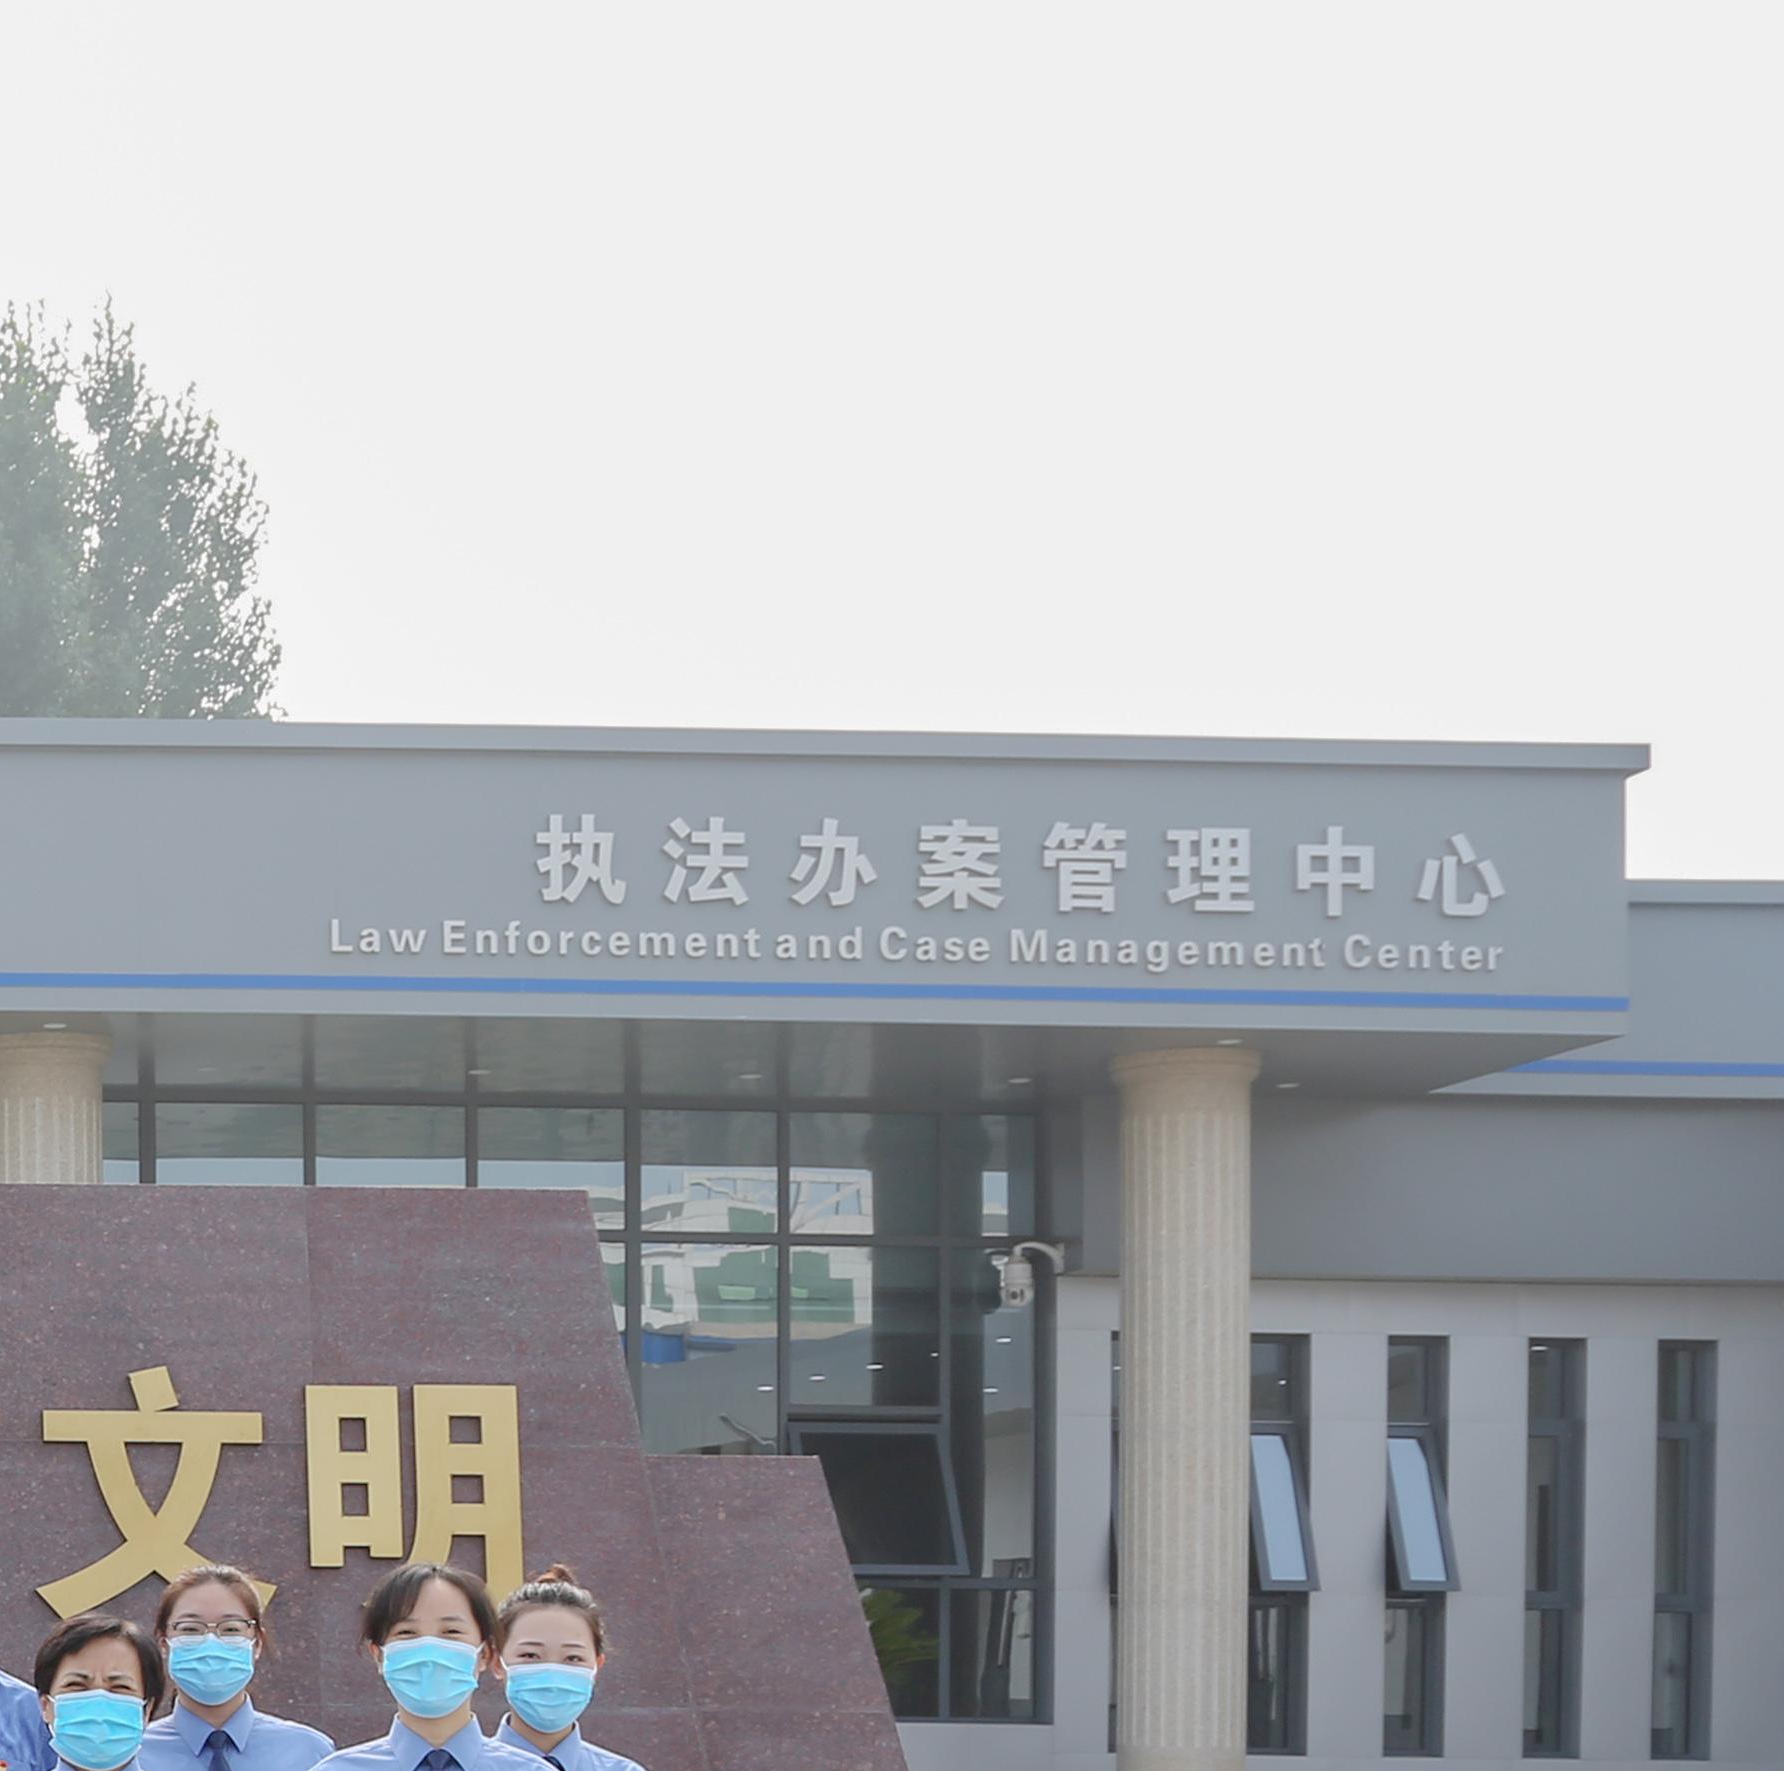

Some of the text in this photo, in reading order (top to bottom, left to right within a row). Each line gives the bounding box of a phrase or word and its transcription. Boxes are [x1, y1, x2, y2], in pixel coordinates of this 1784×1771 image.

[536, 814, 1505, 917] 执法办案管理中心
[330, 919, 1505, 973] Law Enforcement and Case Management Center
[35, 1365, 525, 1620] 文明
